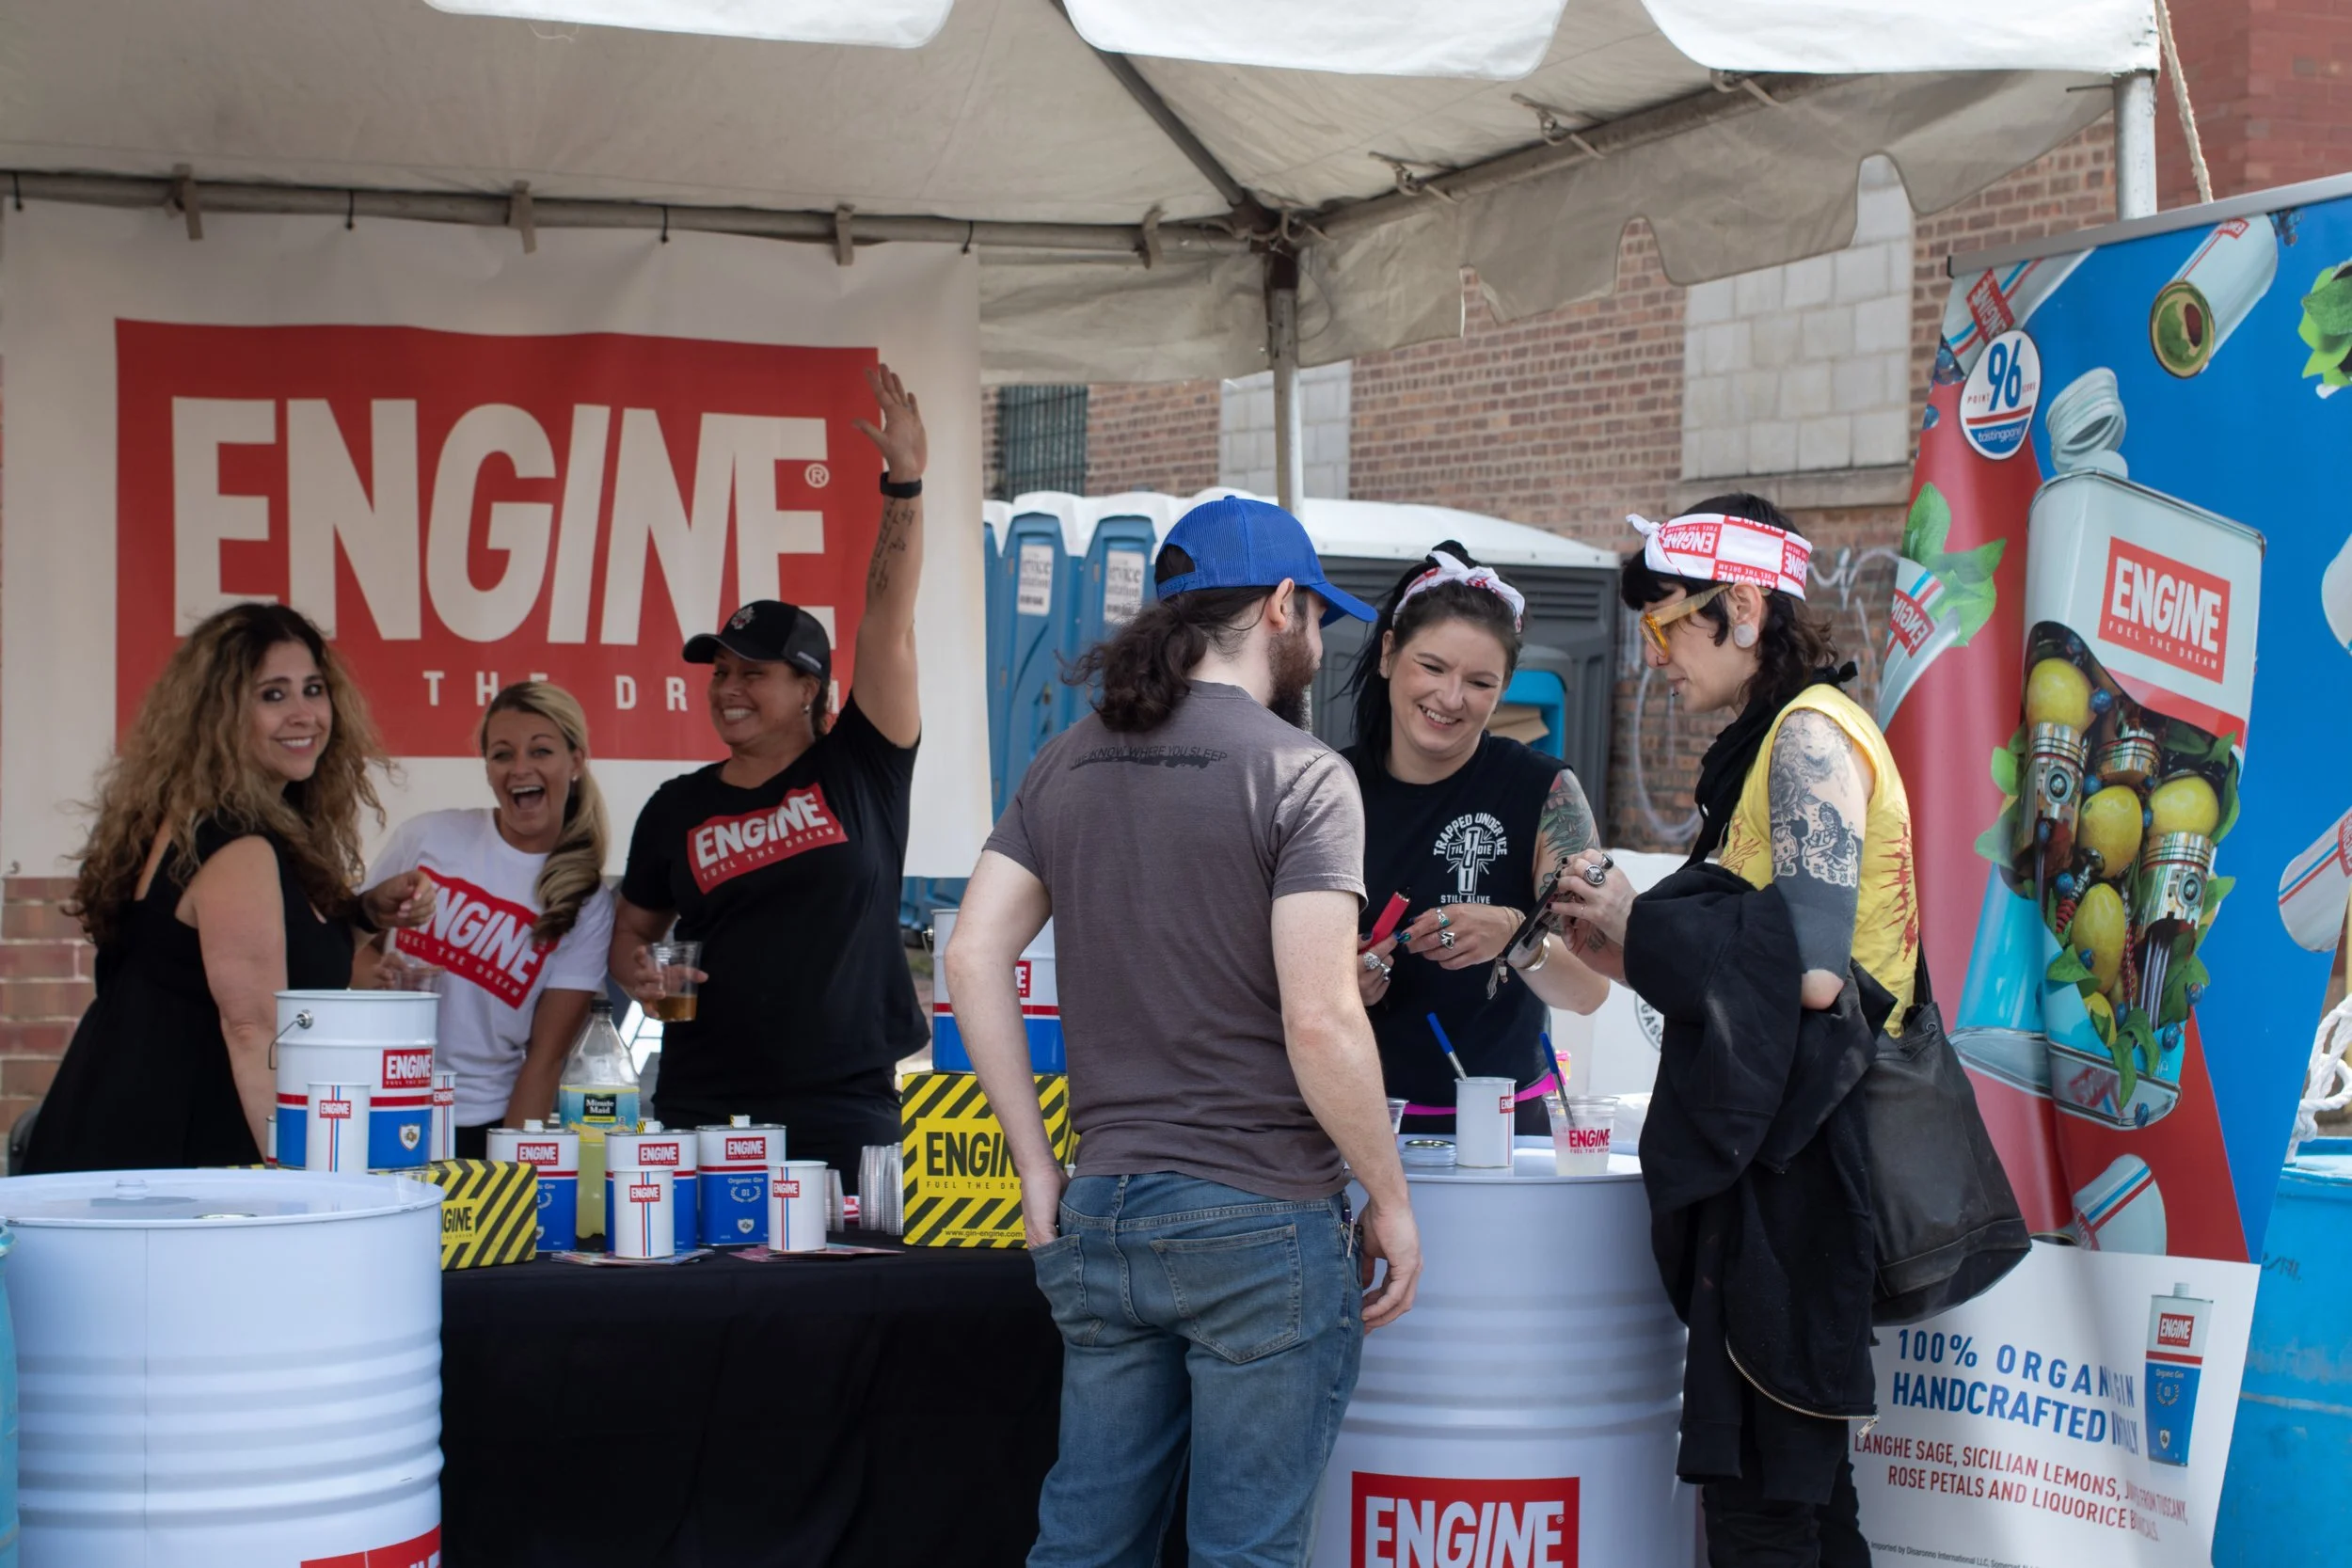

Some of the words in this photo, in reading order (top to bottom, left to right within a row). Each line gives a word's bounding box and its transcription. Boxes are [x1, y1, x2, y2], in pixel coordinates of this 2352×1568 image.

[1987, 339, 2022, 412] 96
[172, 396, 835, 650] ENGINE
[2111, 556, 2222, 655] ENGINE
[2108, 621, 2140, 641] FUEL
[2150, 636, 2171, 652] THE
[2180, 647, 2217, 670] DREAM
[423, 671, 548, 707] TH
[1129, 745, 1167, 758] WHERE
[1168, 746, 1188, 756] YOU
[1188, 747, 1228, 762] SLEEP
[695, 792, 829, 870] ENGINE
[1433, 814, 1473, 856] TRAPPED
[1474, 813, 1504, 837] UNDER
[1496, 836, 1508, 855] ICE
[747, 847, 775, 863] THE
[786, 827, 835, 849] DREAM
[1451, 845, 1464, 855] TIL
[1477, 845, 1493, 854] DIE
[1440, 895, 1463, 904] STILL
[1467, 895, 1491, 904] ALIVE
[437, 946, 467, 966] THE
[387, 1054, 432, 1081] ENGINE
[321, 1101, 351, 1115] ENGINE
[586, 1099, 615, 1107] Minute
[590, 1106, 612, 1115] Maid
[727, 1140, 764, 1156] ENGINE
[1568, 1128, 1611, 1148] ENGINE
[519, 1145, 557, 1161] ENGINE
[641, 1146, 677, 1162] ENGINE
[926, 1132, 1022, 1178] ENGIN
[631, 1186, 660, 1199] ENGINE
[727, 1177, 753, 1185] Organic
[773, 1181, 798, 1194] ENGINE
[927, 1180, 957, 1189] FUEL
[441, 1206, 472, 1233] GINE
[2160, 1318, 2191, 1339] ENGINE
[1899, 1328, 1979, 1369] 100%
[1892, 1371, 2106, 1443] HANDCRAFTED
[1854, 1433, 1913, 1460] LANGHE
[1915, 1439, 1958, 1468] SAGE,
[1963, 1446, 2039, 1478] SICILIAN
[2042, 1462, 2121, 1502] LEMONS,
[1888, 1465, 1926, 1489] ROSE
[1931, 1471, 1984, 1497] PETALS
[1988, 1479, 2027, 1503] AND
[2032, 1487, 2127, 1529] LIQUORICE
[1365, 1496, 1565, 1568] ENGINE
